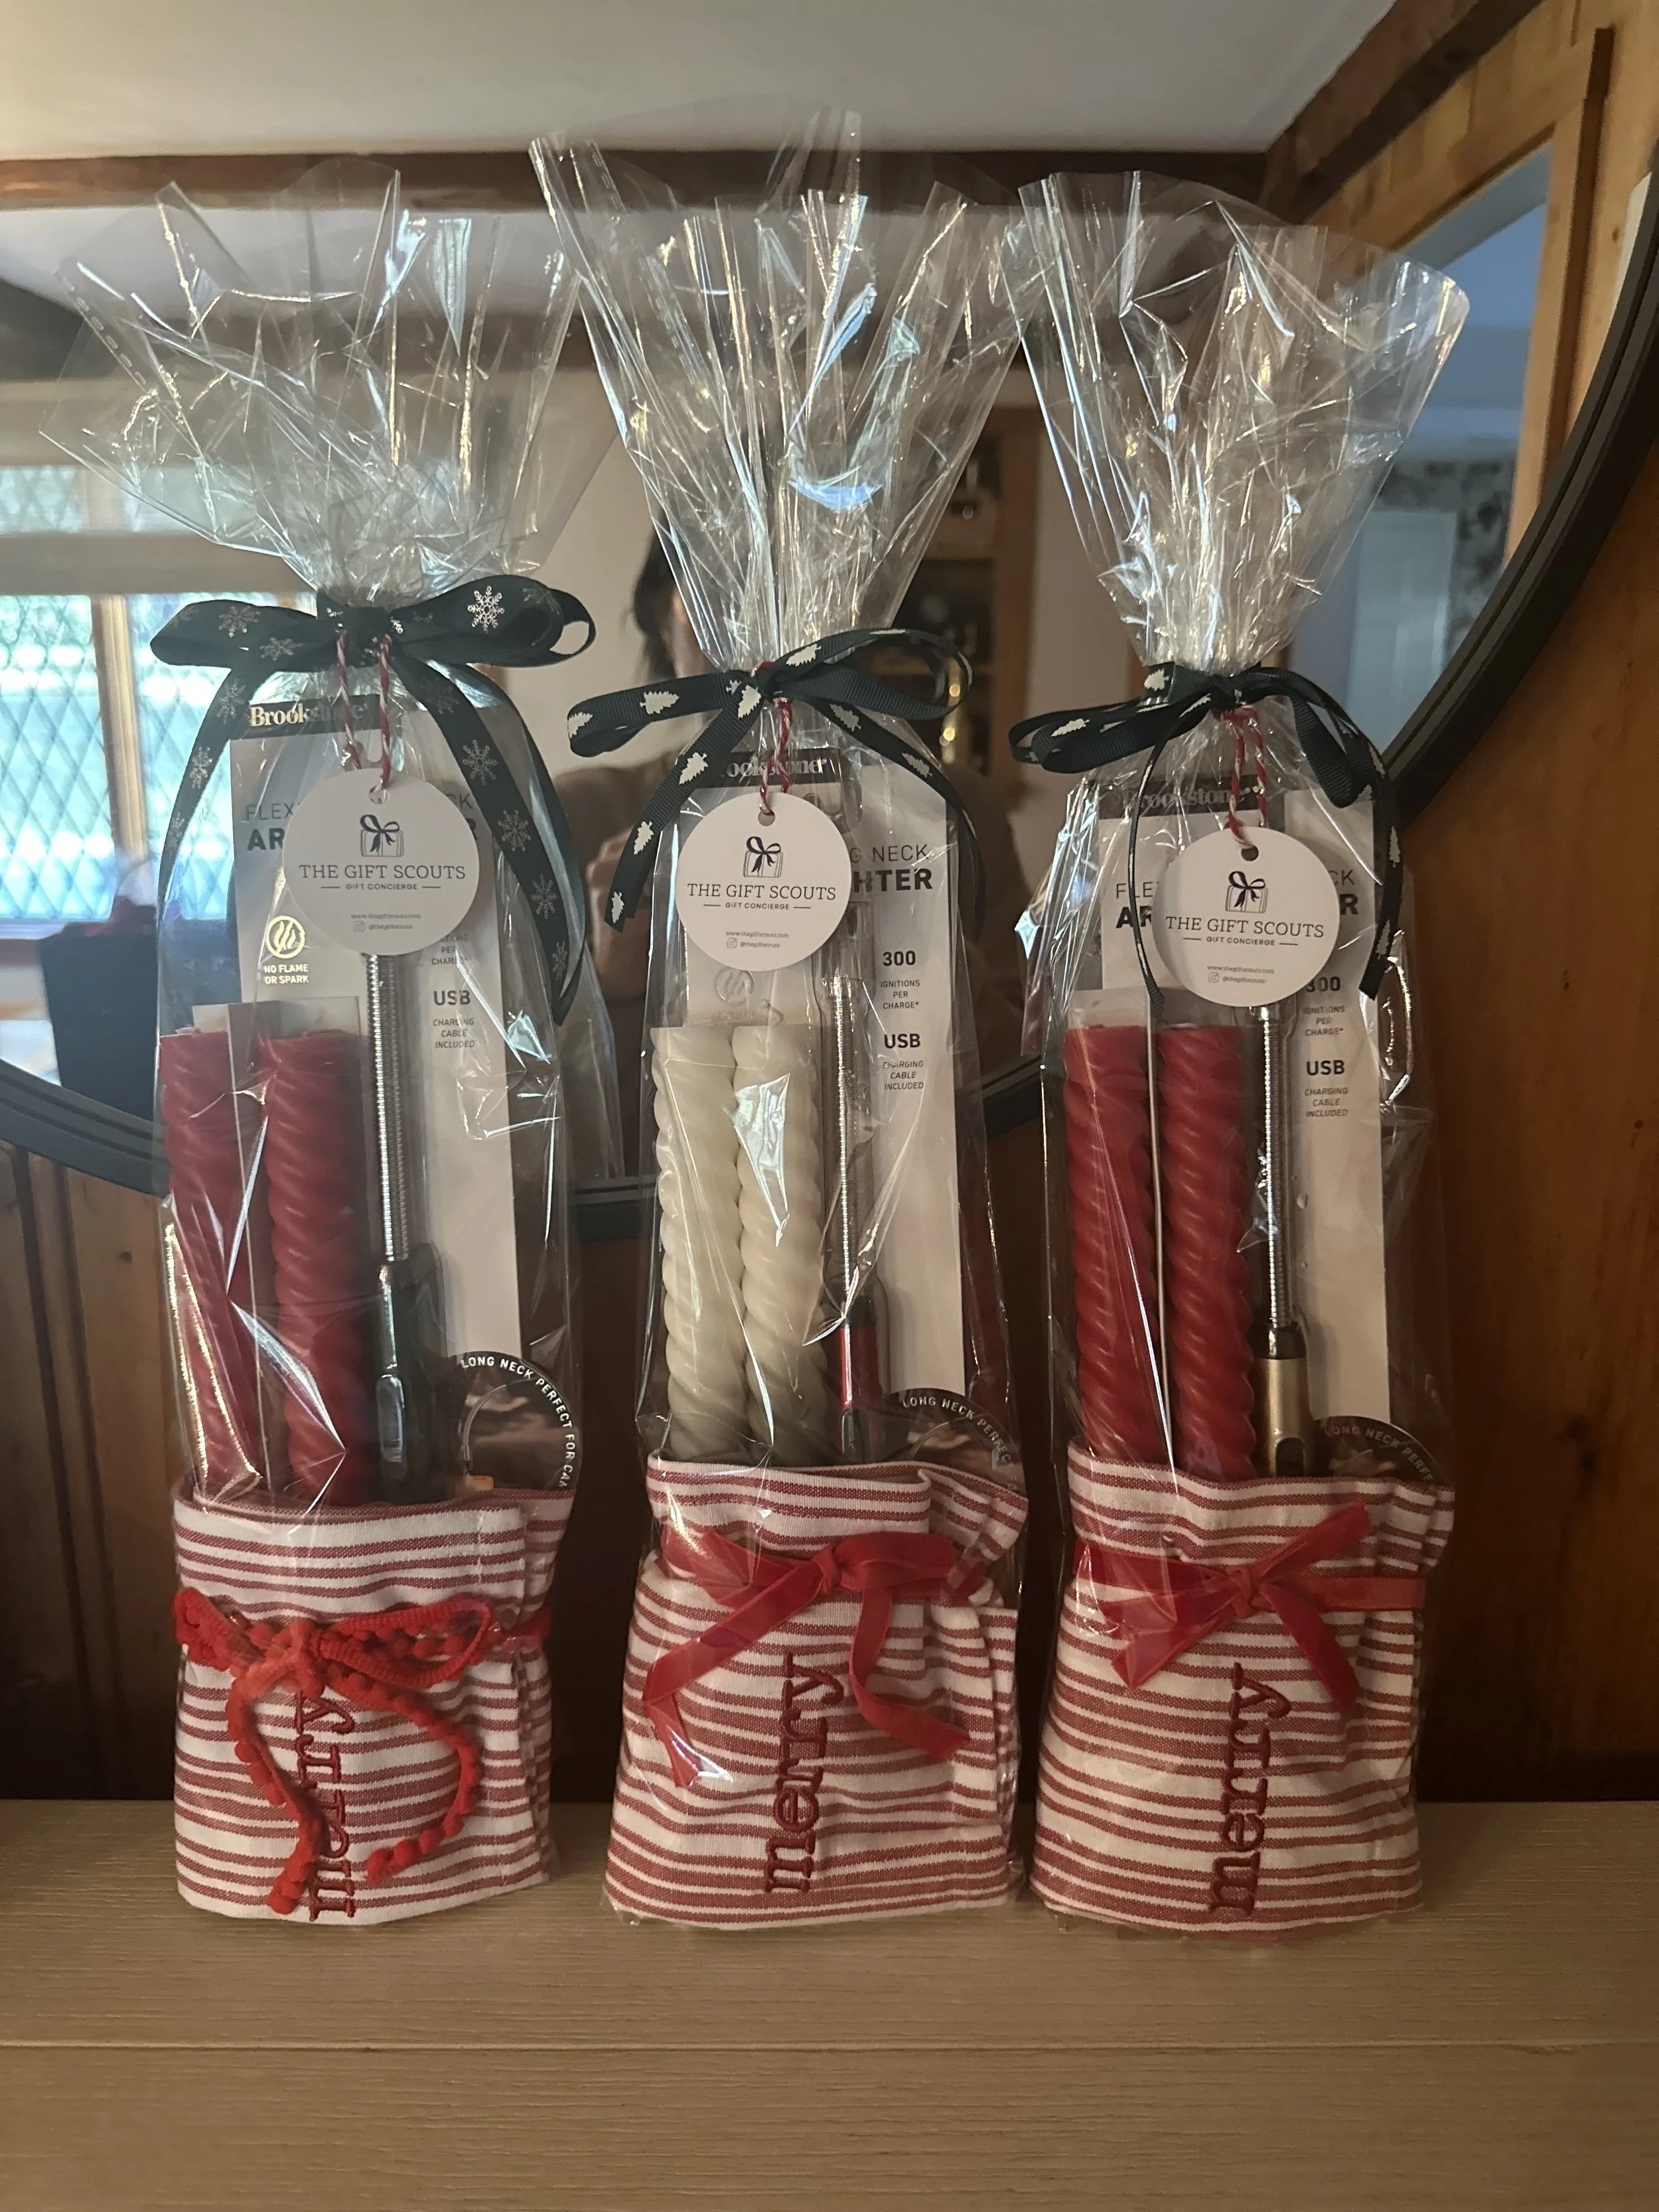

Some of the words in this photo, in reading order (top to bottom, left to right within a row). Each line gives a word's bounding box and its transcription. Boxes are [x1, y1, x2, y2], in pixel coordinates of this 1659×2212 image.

[246, 802, 301, 821] FLEX
[873, 844, 929, 861] NECK
[299, 865, 339, 879] THE
[344, 865, 388, 879] GIFT
[394, 865, 466, 879] SCOUTS
[687, 883, 721, 897] THE
[726, 884, 764, 898] GIFT
[770, 885, 836, 900] SCOUTS
[1166, 916, 1202, 930] THE
[1207, 918, 1249, 933] GIFT
[1254, 921, 1325, 938] SCOUTS
[1227, 937, 1275, 946] CONCIERGE
[883, 950, 916, 966] 300
[279, 964, 309, 973] FLAME
[265, 976, 277, 984] OR
[279, 975, 310, 984] SPARK
[881, 980, 920, 988] IGNITIONS
[1305, 976, 1340, 993] 300
[433, 990, 471, 1005] USB
[435, 1040, 474, 1049] INCLUDED
[884, 1033, 921, 1049] USB
[890, 1071, 916, 1080] CABLE
[1306, 1060, 1346, 1076] USB
[884, 1082, 924, 1090] INCLUDED
[1304, 1087, 1348, 1096] CHARGING
[1313, 1098, 1340, 1107] CABLE
[1305, 1108, 1348, 1118] INCLUDED
[461, 1356, 495, 1369] LONG
[500, 1359, 534, 1380] NECK
[536, 1378, 572, 1429] PERFECT
[565, 1434, 575, 1460] FOR
[902, 1396, 936, 1408] LONG
[941, 1398, 975, 1420] NECK
[1324, 1426, 1360, 1437] LONG
[1364, 1428, 1400, 1449] NECK
[764, 1651, 844, 1893] merry
[1208, 1662, 1291, 1916] merry
